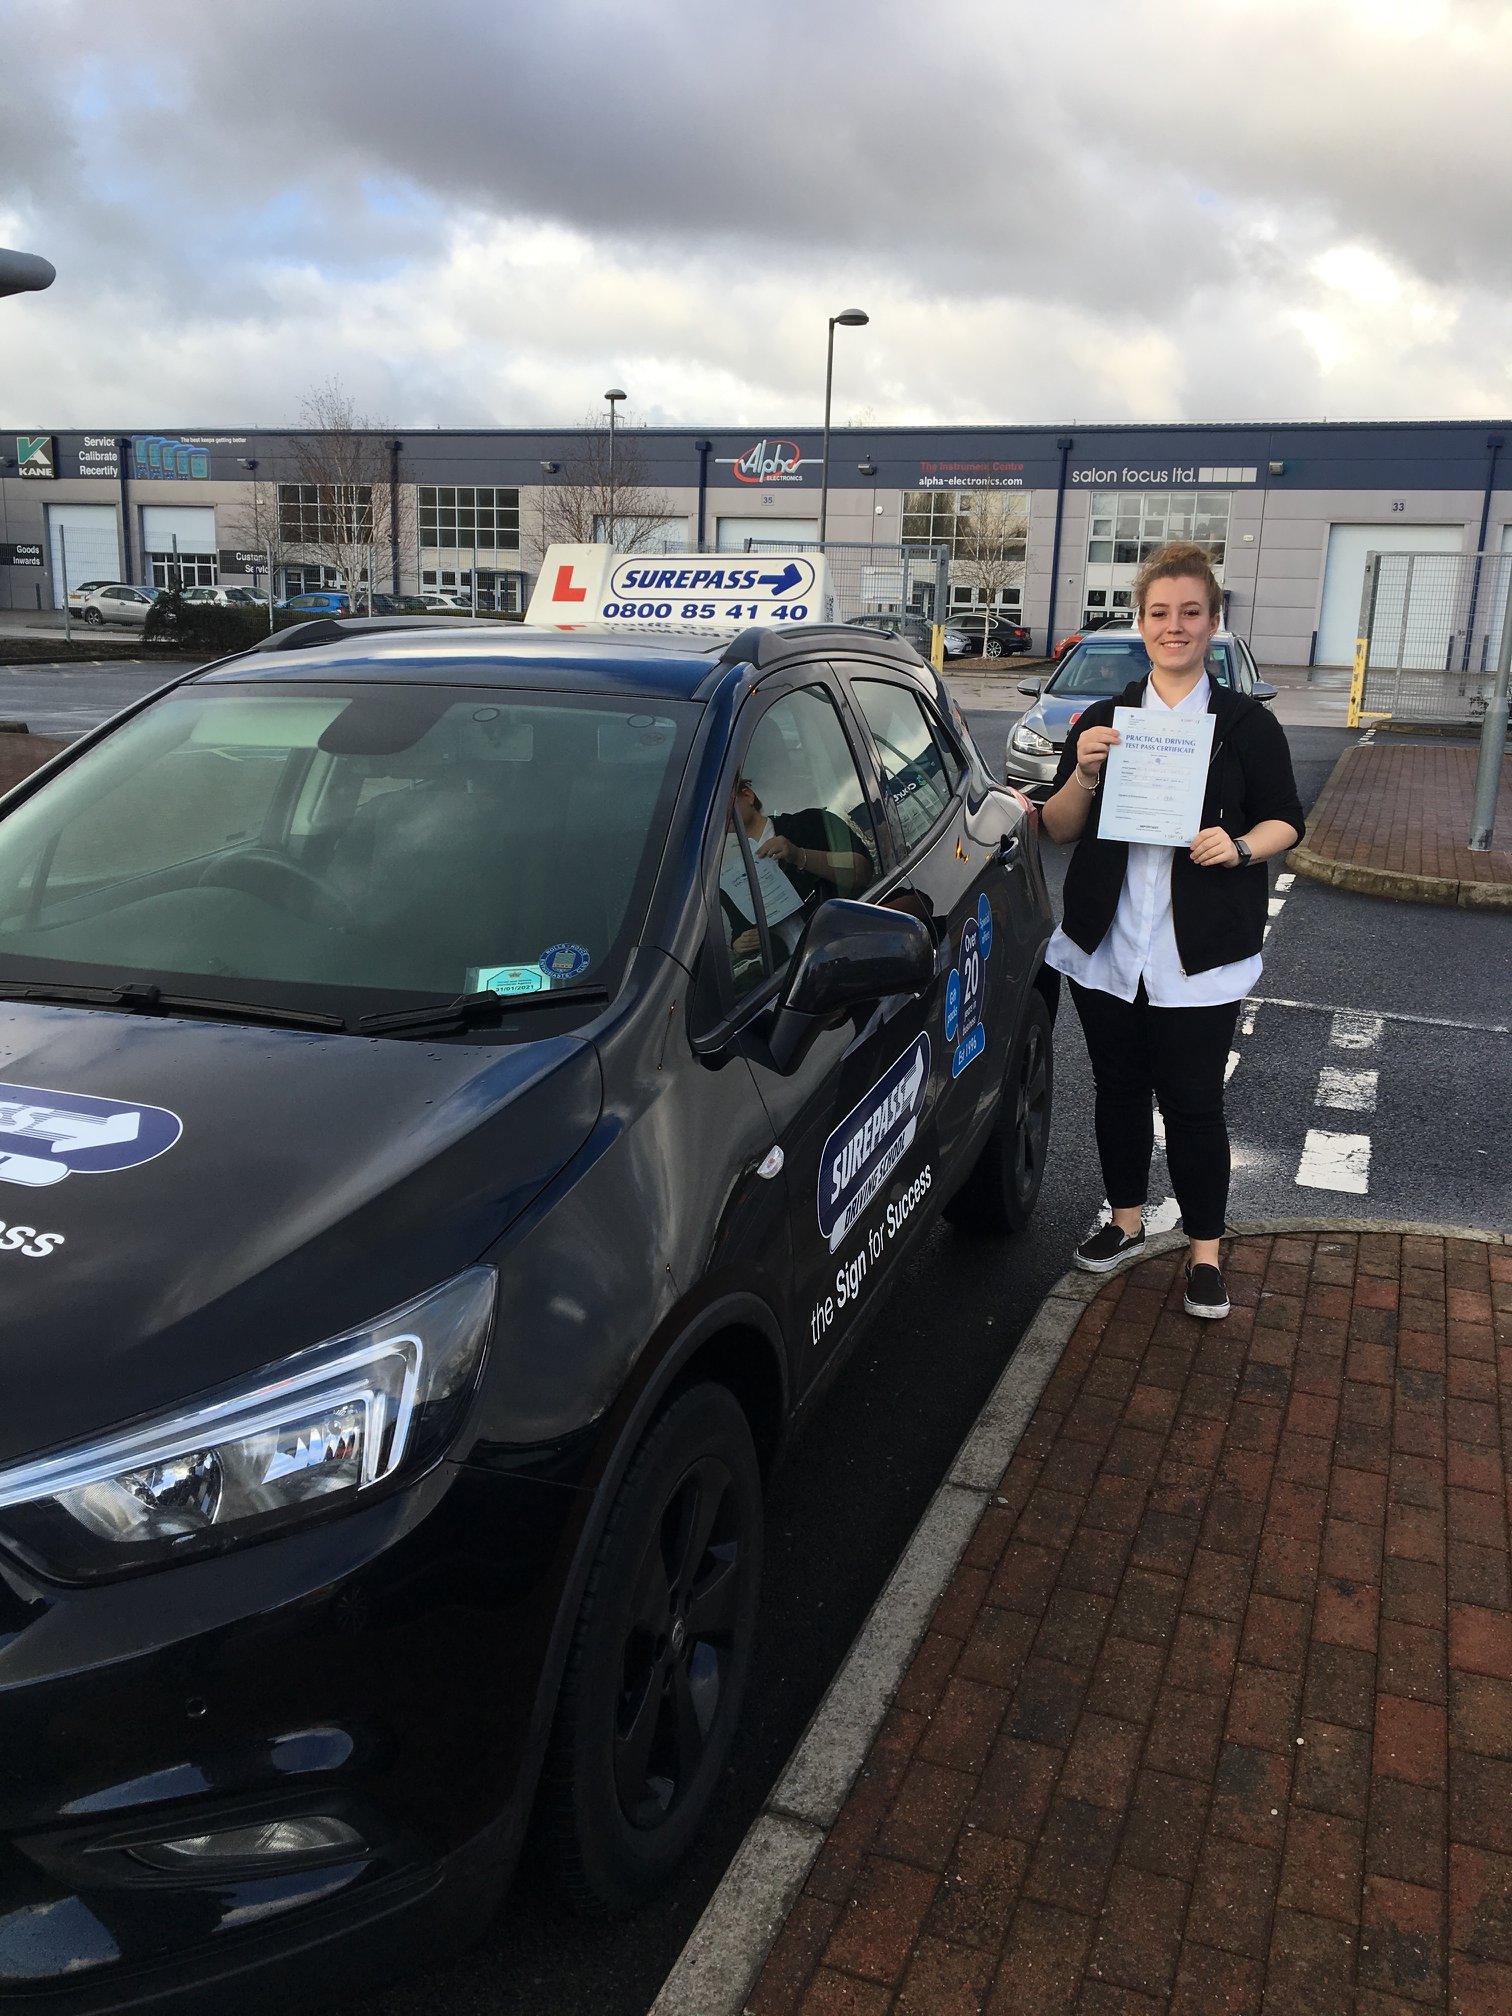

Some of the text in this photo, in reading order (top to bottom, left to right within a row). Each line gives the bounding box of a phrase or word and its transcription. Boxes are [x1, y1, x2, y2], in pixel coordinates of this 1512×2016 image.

[84, 436, 115, 447] Service
[79, 451, 118, 461] Calibrate
[738, 440, 803, 483] Alpha
[18, 467, 53, 476] KANE
[79, 465, 118, 478] Recertify
[920, 462, 937, 471] The
[940, 462, 990, 471] Instrument
[918, 476, 1023, 487] alpha-electronics.com
[1072, 467, 1196, 483] salon focus ltd.
[763, 496, 773, 504] 35
[1392, 502, 1405, 512] 33
[16, 545, 40, 554] Goods
[12, 556, 41, 566] Inwards
[245, 564, 269, 574] Servic
[551, 565, 587, 602] L
[621, 569, 760, 590] SUREPASS
[602, 602, 673, 620] 0800
[680, 603, 716, 620] 85
[725, 603, 758, 620] 41
[770, 604, 808, 621] 40
[1125, 734, 1197, 747] PRACTICAL DRIVING
[1125, 742, 1196, 754] TEST PASS CERTIFICATE
[964, 932, 977, 953] Over
[964, 950, 979, 1005] 20
[831, 1083, 906, 1205] SUREPASS
[843, 1131, 906, 1232] DRIVING SCHOOL
[810, 1164, 932, 1345] the Sign for Success
